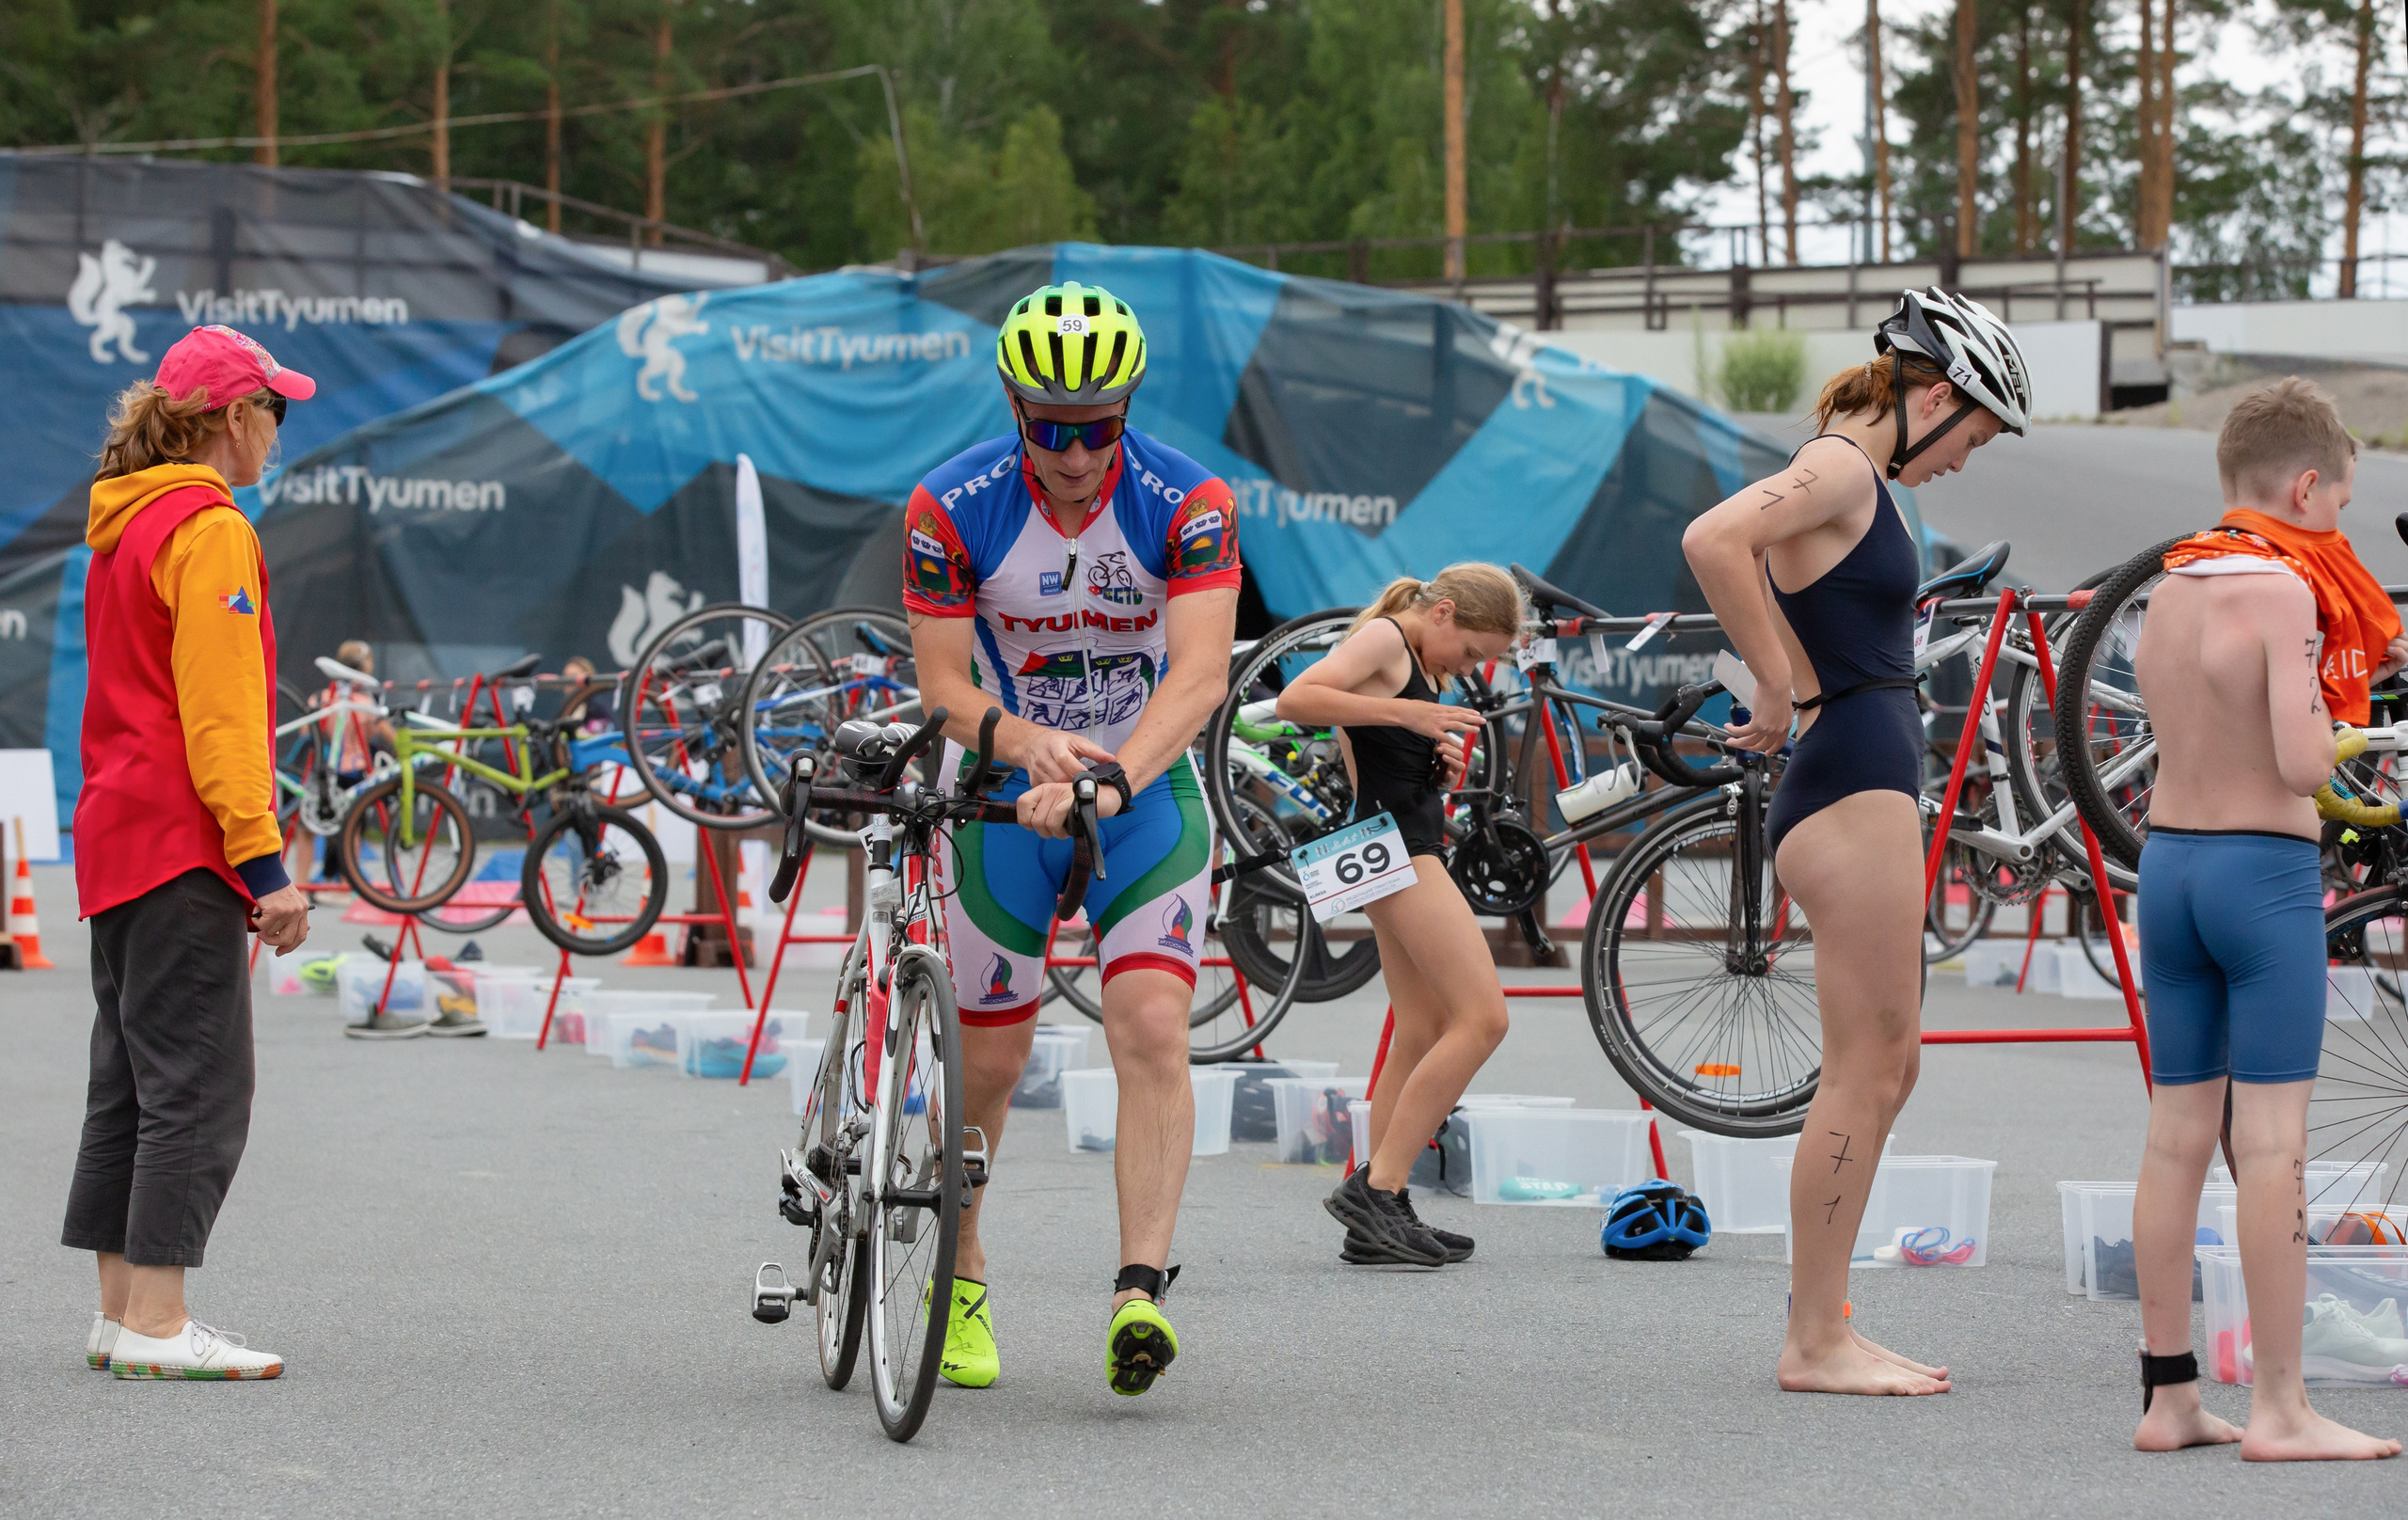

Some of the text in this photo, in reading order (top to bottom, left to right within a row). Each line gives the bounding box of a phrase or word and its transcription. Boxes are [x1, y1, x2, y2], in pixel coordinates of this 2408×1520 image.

[176, 288, 408, 331] VisitTyumen
[1062, 319, 1083, 332] 59
[731, 325, 971, 370] VisitTyumen
[1951, 365, 1973, 388] 71
[2004, 354, 2024, 397] MET
[259, 465, 506, 515] VisitTyumen
[940, 453, 1017, 512] PRO
[1042, 574, 1060, 586] NW
[998, 609, 1158, 632] TYUMEN
[1335, 842, 1391, 884] 69
